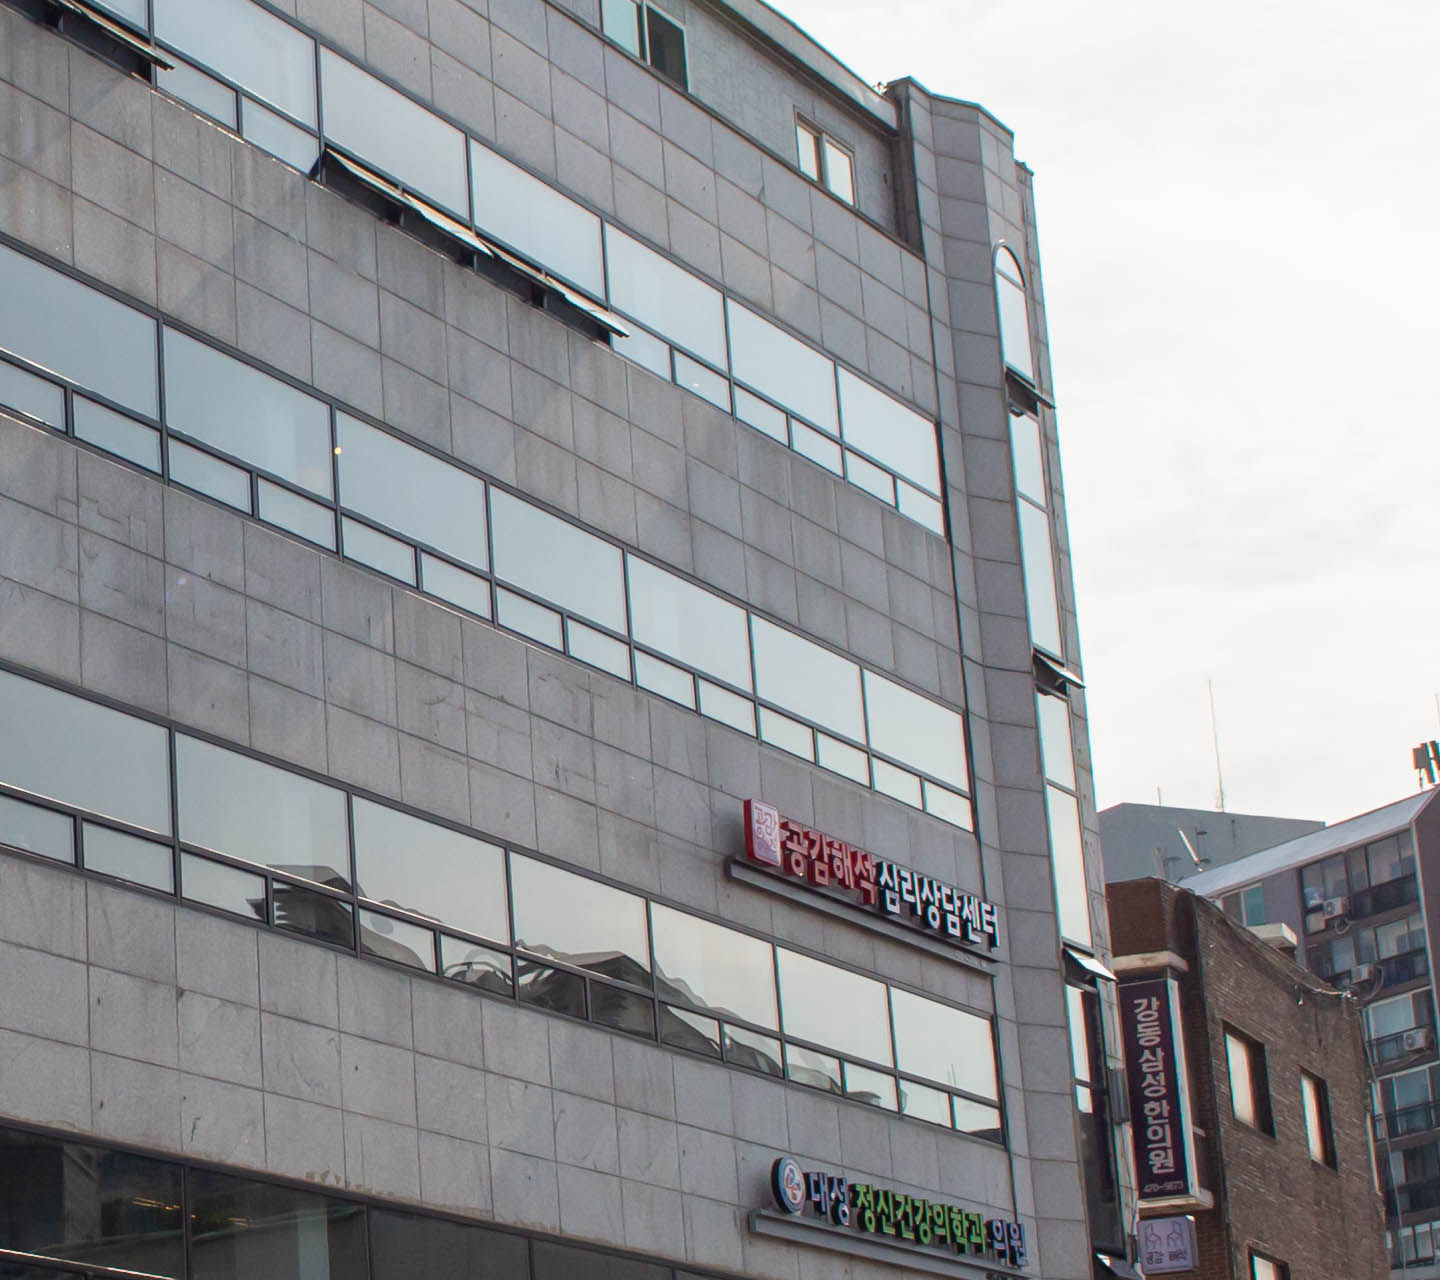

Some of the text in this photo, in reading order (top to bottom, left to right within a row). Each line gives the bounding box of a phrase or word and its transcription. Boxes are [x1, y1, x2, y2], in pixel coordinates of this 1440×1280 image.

[784, 821, 1000, 952] 공감해석 심리상담센터
[1134, 996, 1175, 1174] 강동삼성한의원
[809, 1172, 1029, 1268] 대성 정신건강의학과 의원
